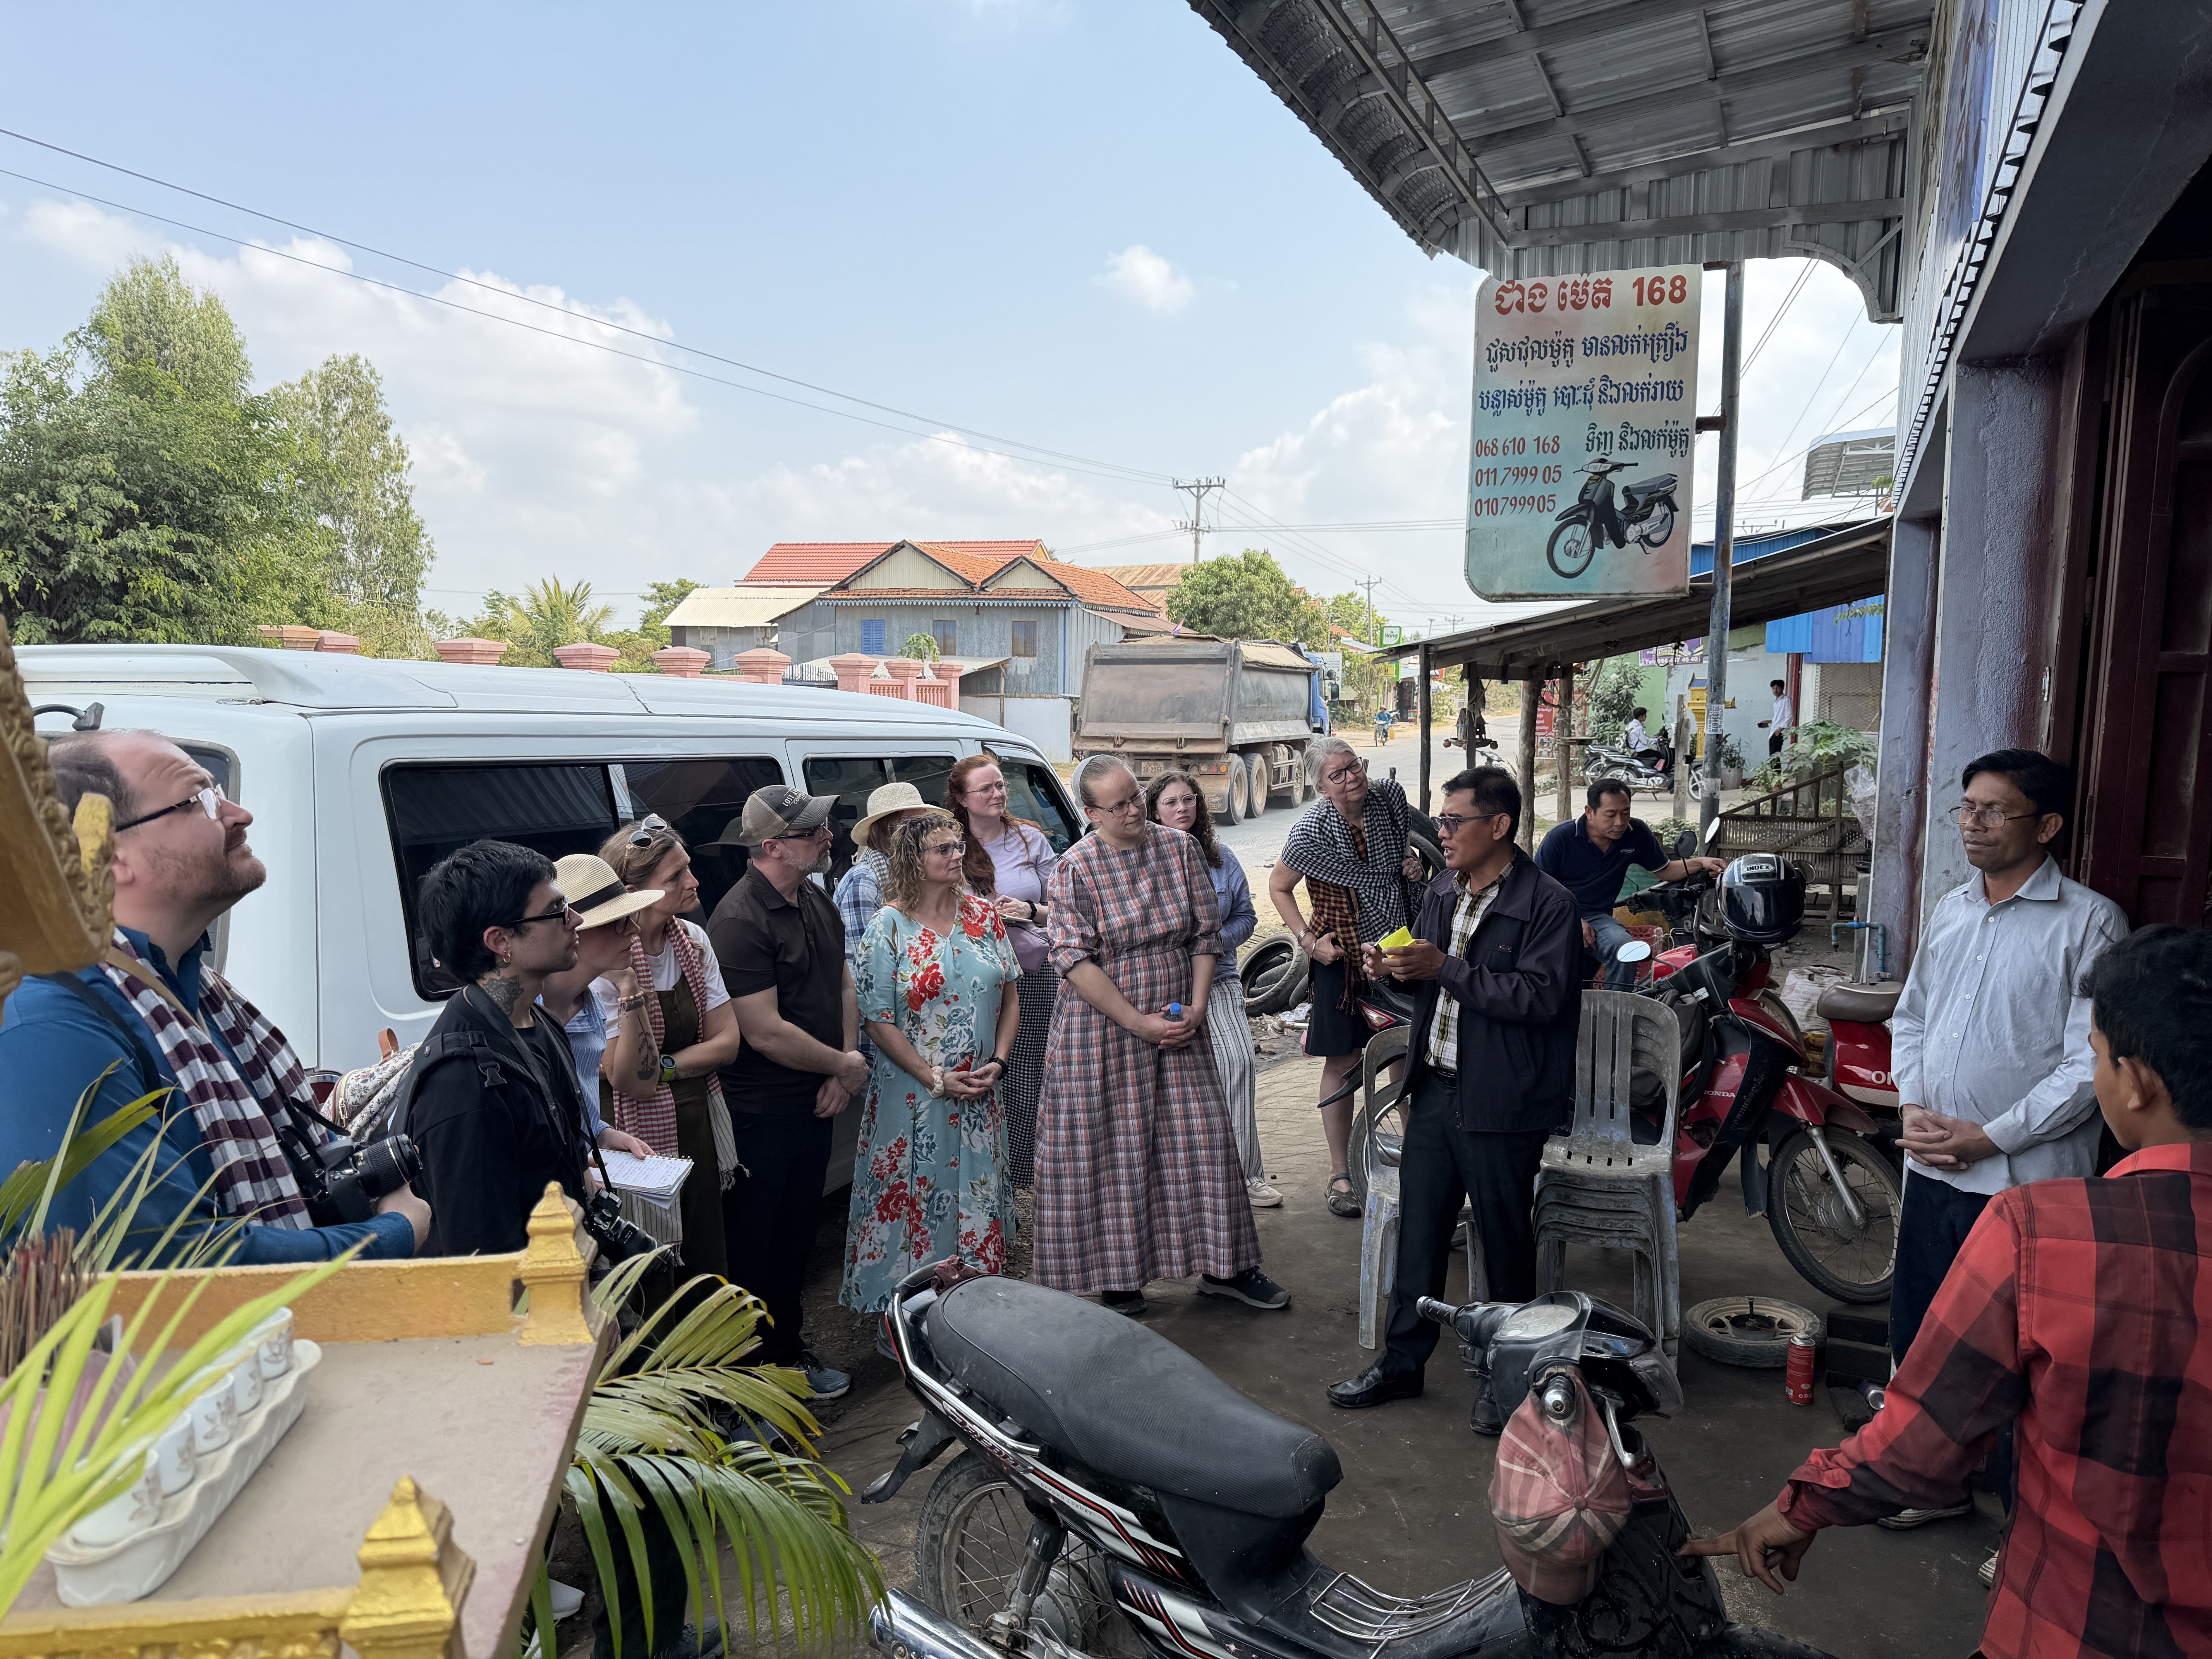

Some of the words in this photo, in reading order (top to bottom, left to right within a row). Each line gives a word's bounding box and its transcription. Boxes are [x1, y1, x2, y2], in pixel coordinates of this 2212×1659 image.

[1632, 275, 1686, 306] 168
[1475, 438, 1499, 458] 068
[1502, 437, 1525, 456] 610
[1533, 435, 1560, 455] 168
[1542, 465, 1562, 484] 05
[782, 794, 795, 807] LOST
[1041, 1482, 1065, 1499] BEYOND
[1067, 1499, 1092, 1516] LUXURY
